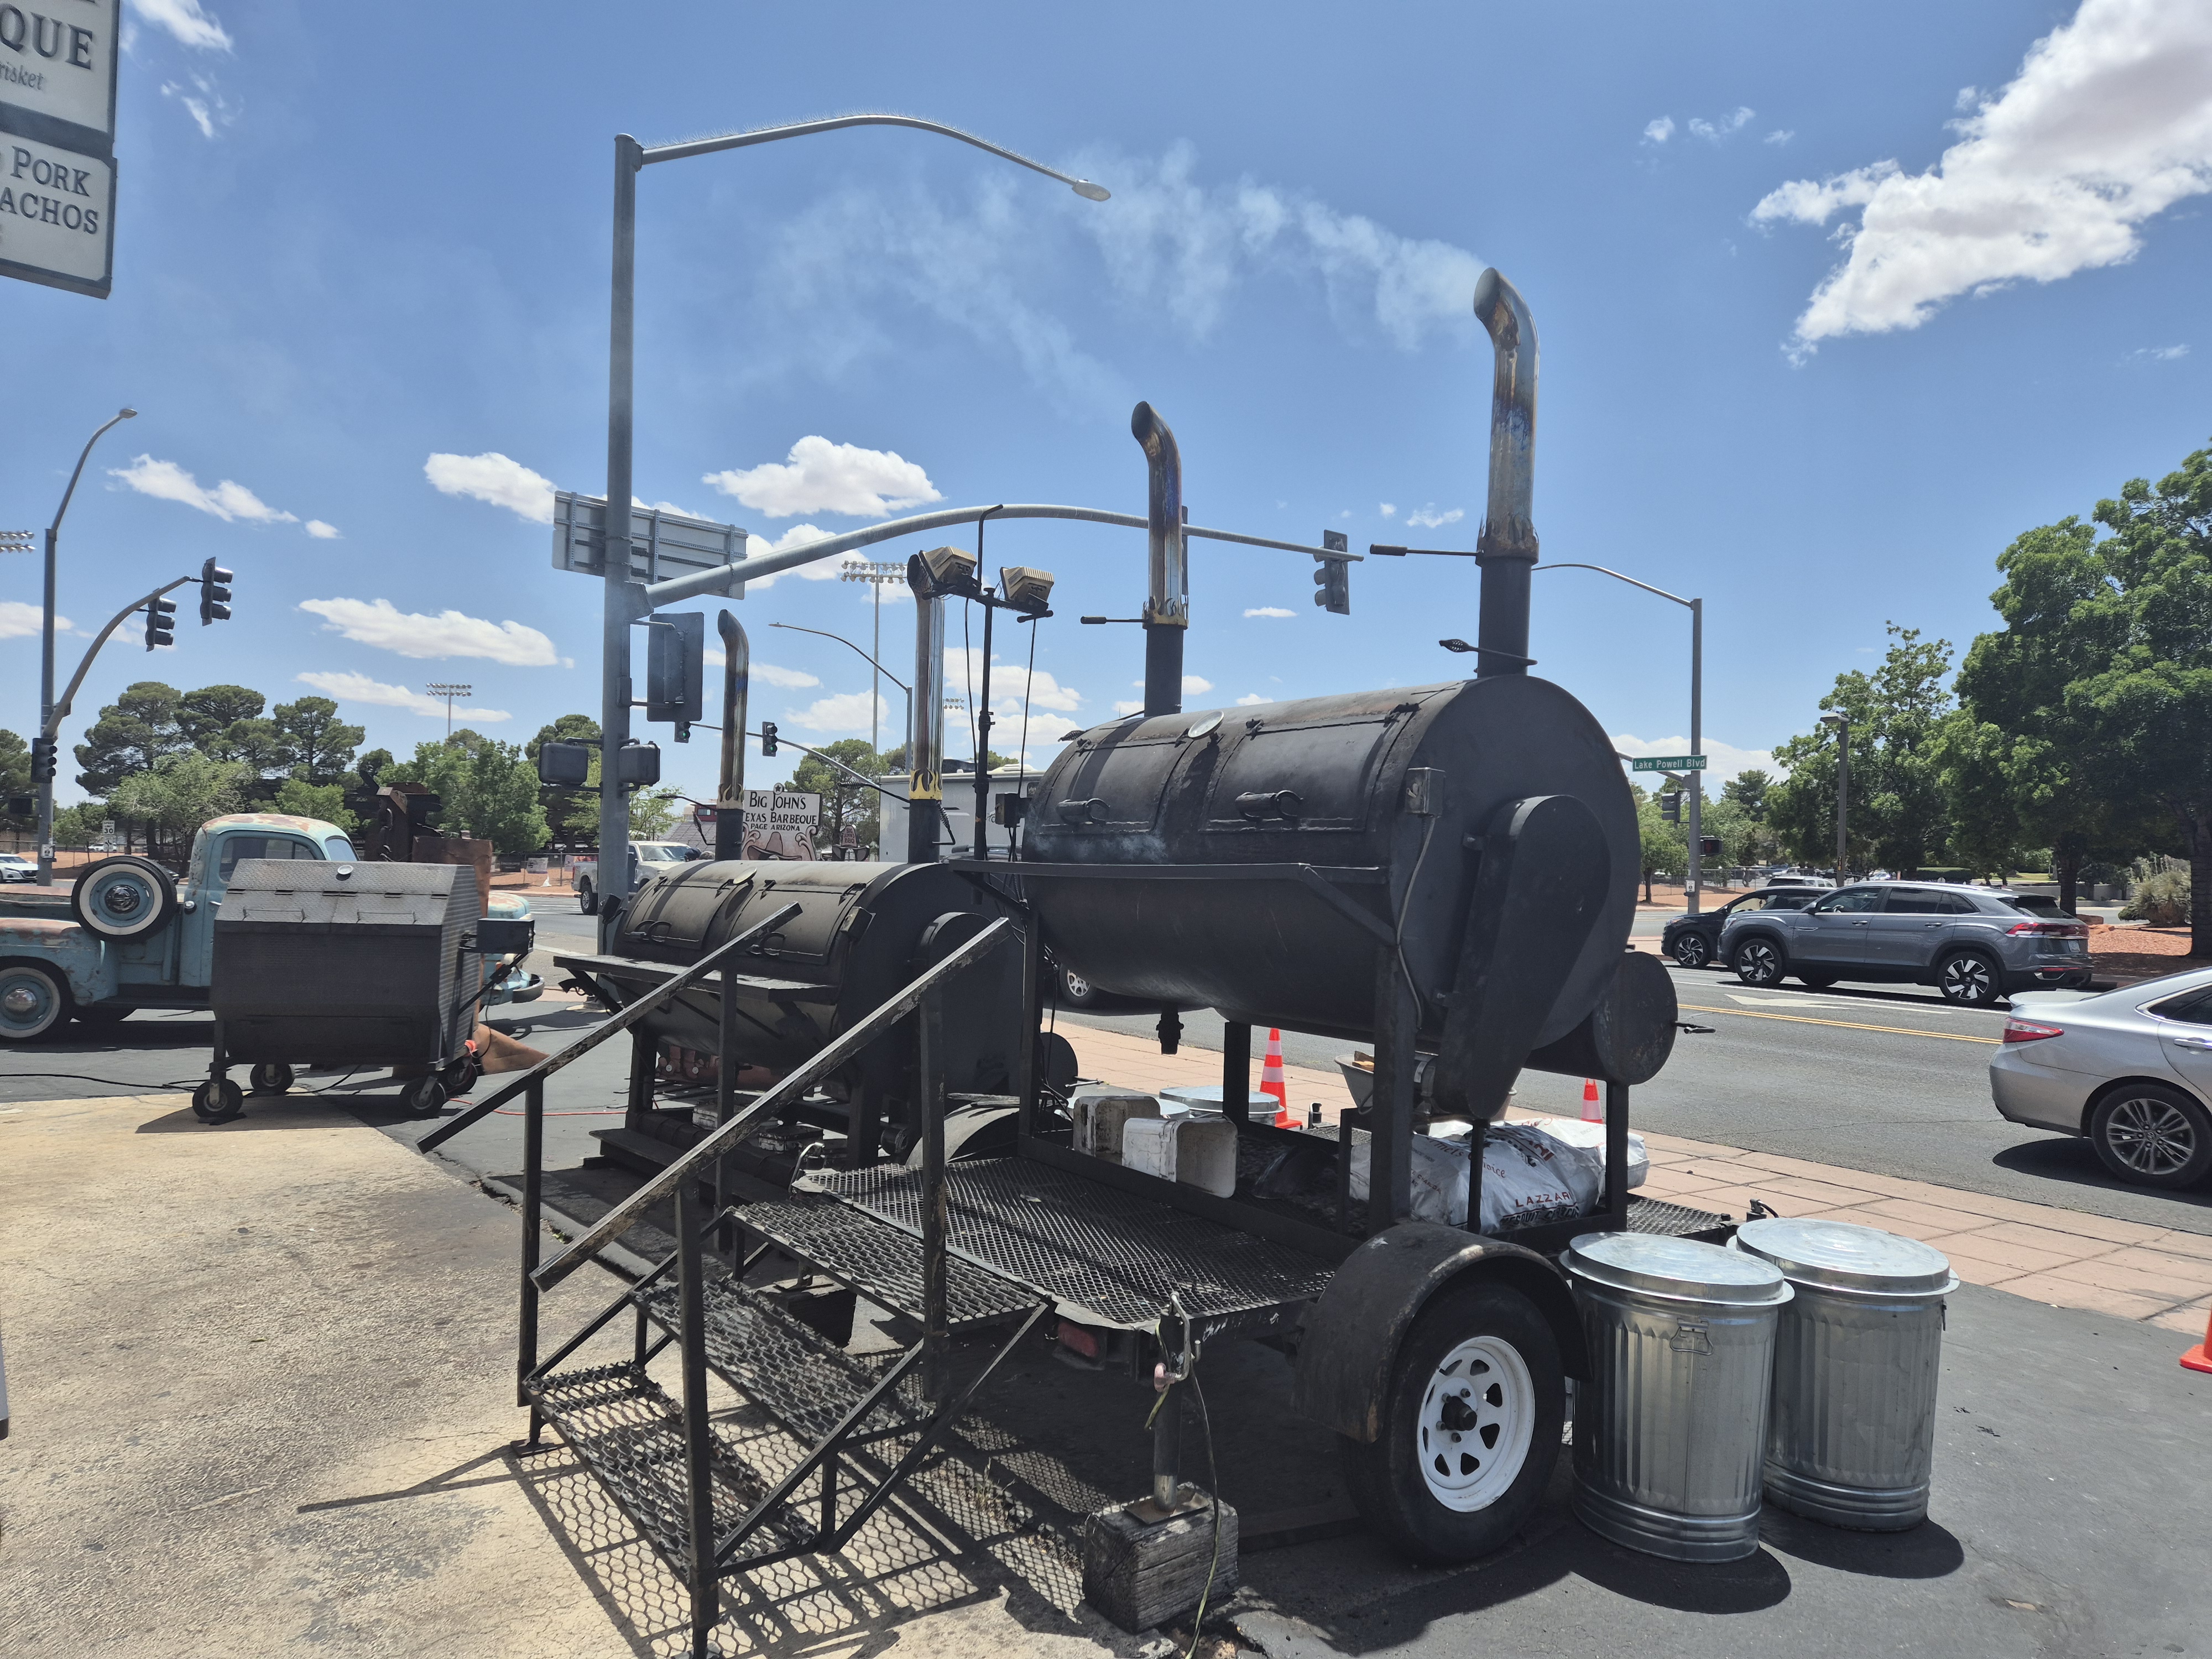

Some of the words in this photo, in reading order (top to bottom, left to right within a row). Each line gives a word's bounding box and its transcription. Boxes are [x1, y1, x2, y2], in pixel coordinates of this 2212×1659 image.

[11, 146, 91, 197] PORK
[0, 187, 98, 234] ACHOS
[1635, 760, 1652, 769] Lake
[1656, 759, 1682, 768] Powell
[1687, 758, 1705, 767] Blvd
[749, 791, 767, 807] BIG
[770, 792, 806, 811] JOHN'S
[743, 811, 766, 822] EXAS
[770, 812, 817, 825] BARBEQUE
